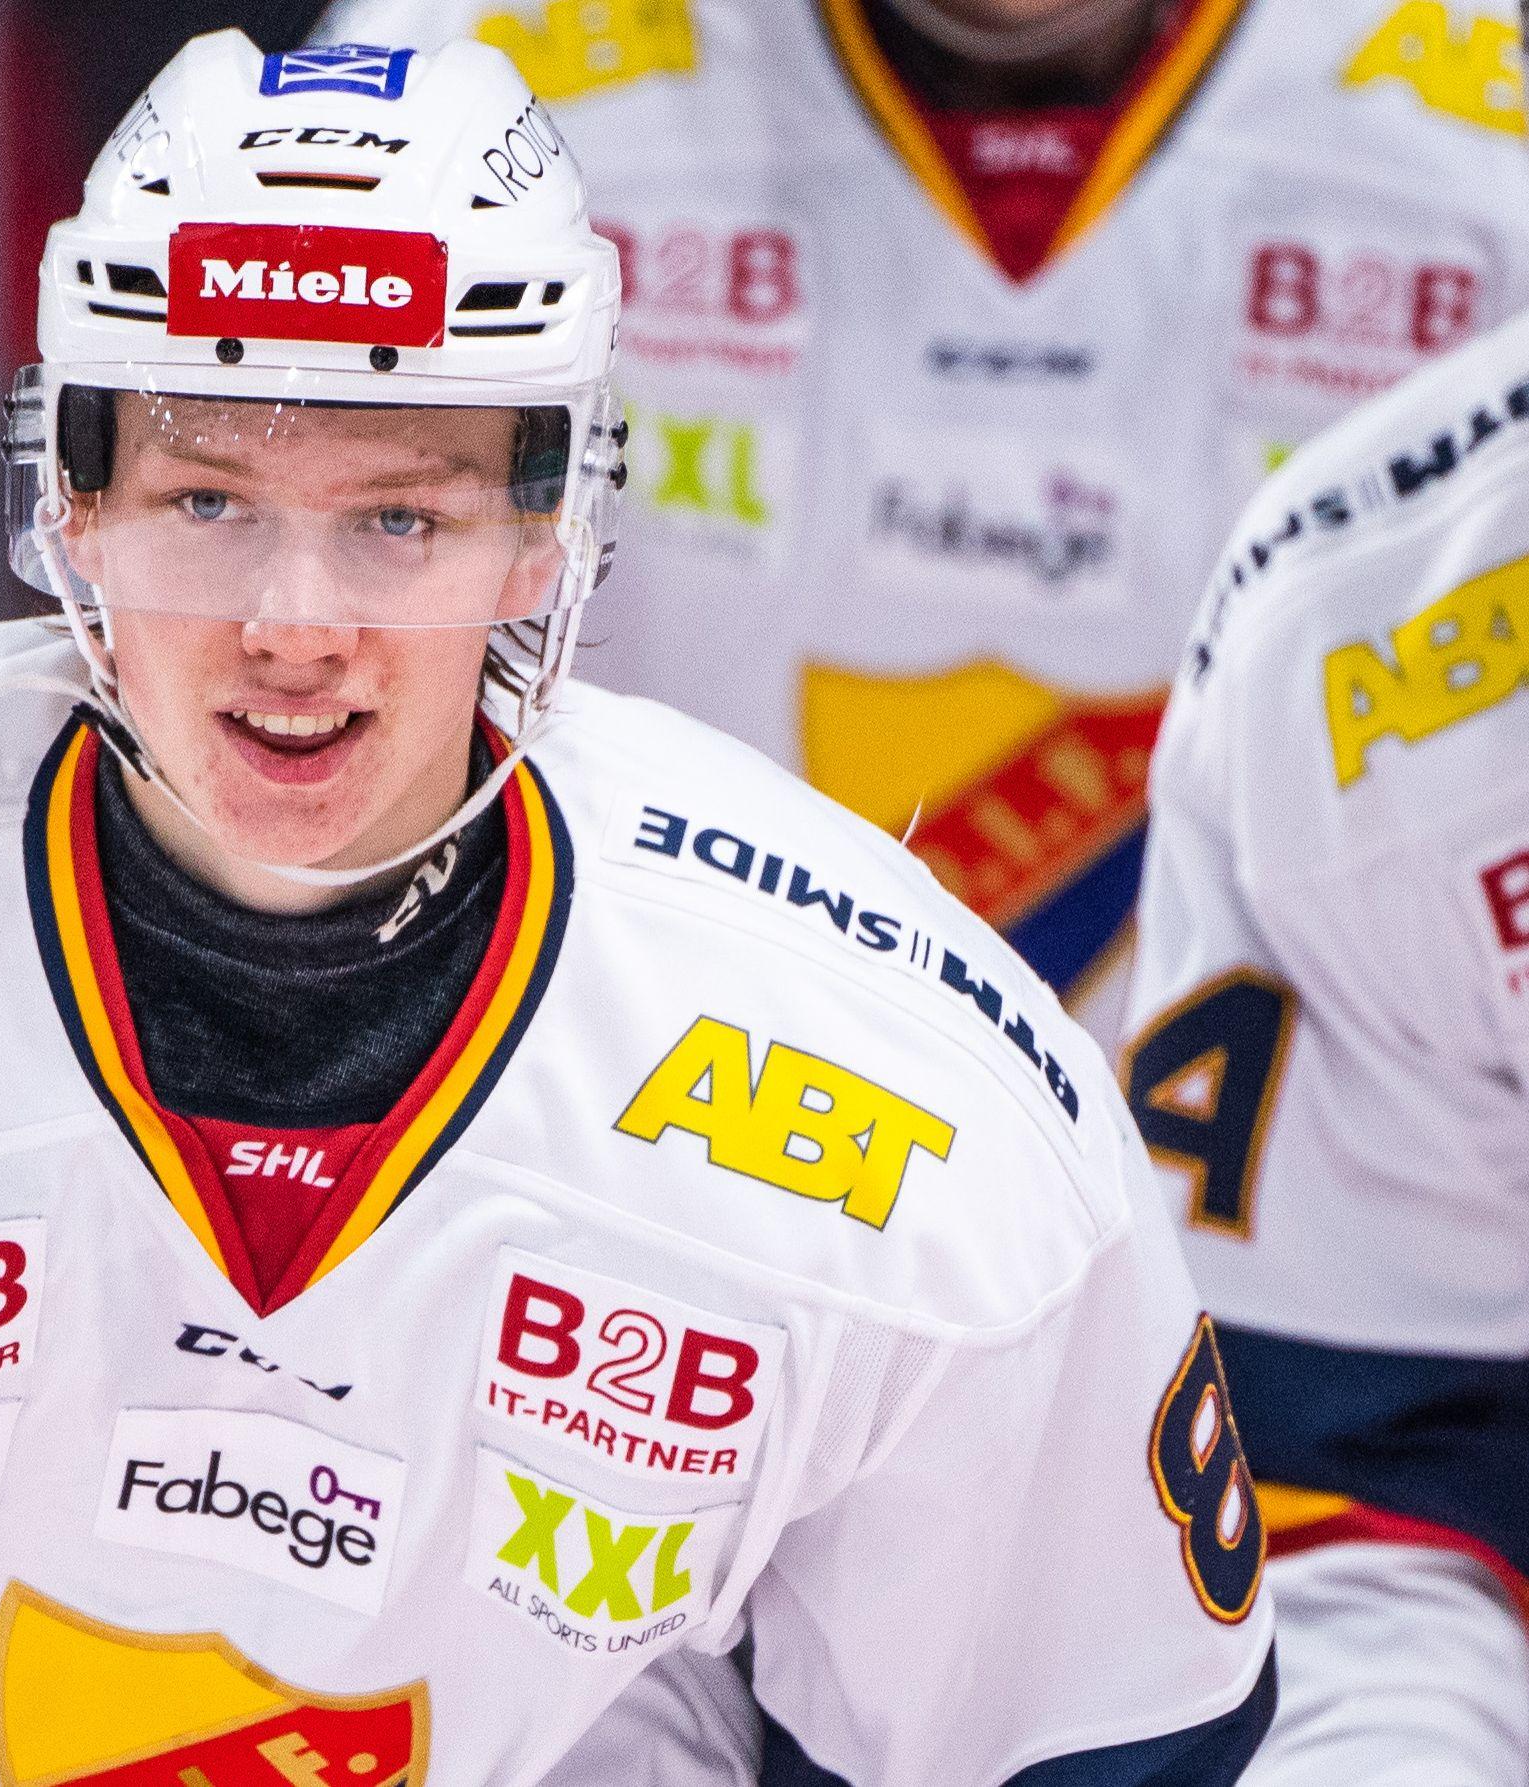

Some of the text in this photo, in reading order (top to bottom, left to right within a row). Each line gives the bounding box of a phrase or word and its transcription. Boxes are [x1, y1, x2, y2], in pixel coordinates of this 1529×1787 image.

[239, 127, 410, 154] CCM
[199, 259, 413, 308] Miele
[634, 806, 903, 952] SMIDE
[225, 1141, 334, 1188] SHL
[612, 1014, 957, 1232] ABT
[497, 1273, 760, 1431] B2B
[488, 1381, 738, 1475] IT-PARTNER
[117, 1450, 377, 1568] Fabege
[496, 1469, 696, 1622] XXL
[488, 1576, 686, 1653] ALL SPORTS UNITED
